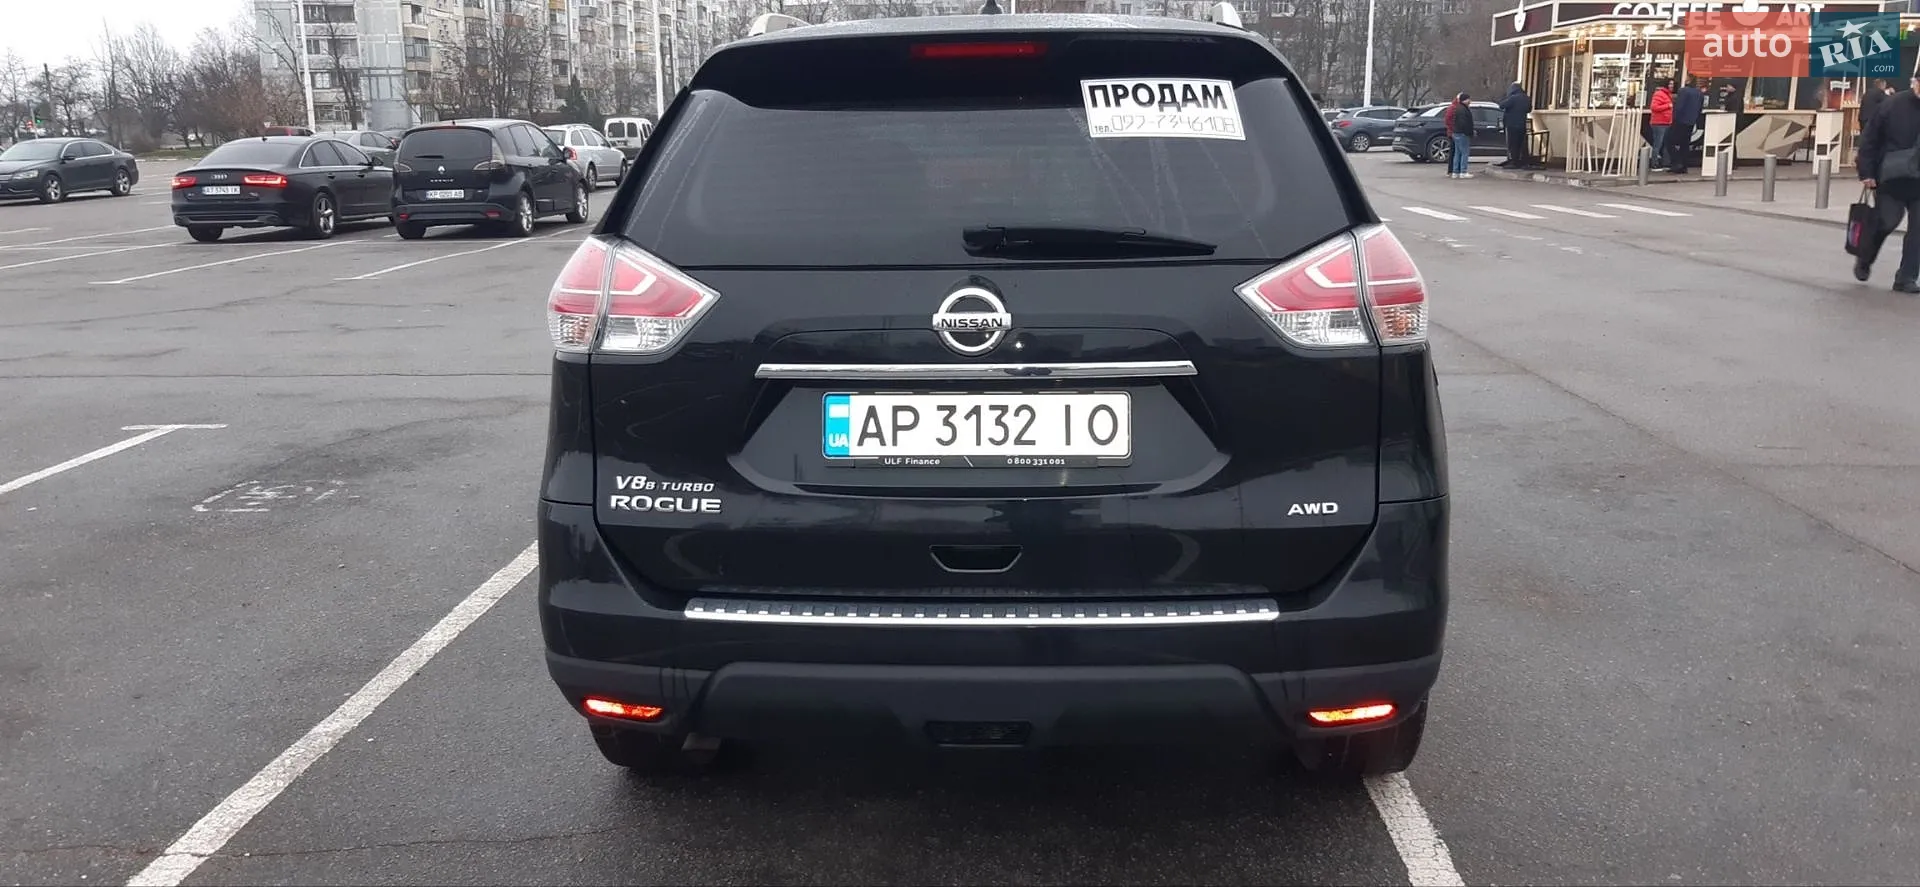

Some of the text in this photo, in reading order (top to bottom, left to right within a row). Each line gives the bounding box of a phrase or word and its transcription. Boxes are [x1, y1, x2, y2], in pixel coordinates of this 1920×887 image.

[1776, 3, 1825, 26] ART
[1088, 83, 1228, 112] ПРОДАМ
[941, 318, 1003, 328] NISSAN
[856, 405, 920, 447] AP
[935, 405, 1036, 446] 3132
[828, 433, 849, 448] UA
[884, 457, 941, 466] ULF Finance
[661, 482, 715, 492] TURBO
[610, 495, 722, 513] ROGUE
[1287, 502, 1339, 516] AWD
